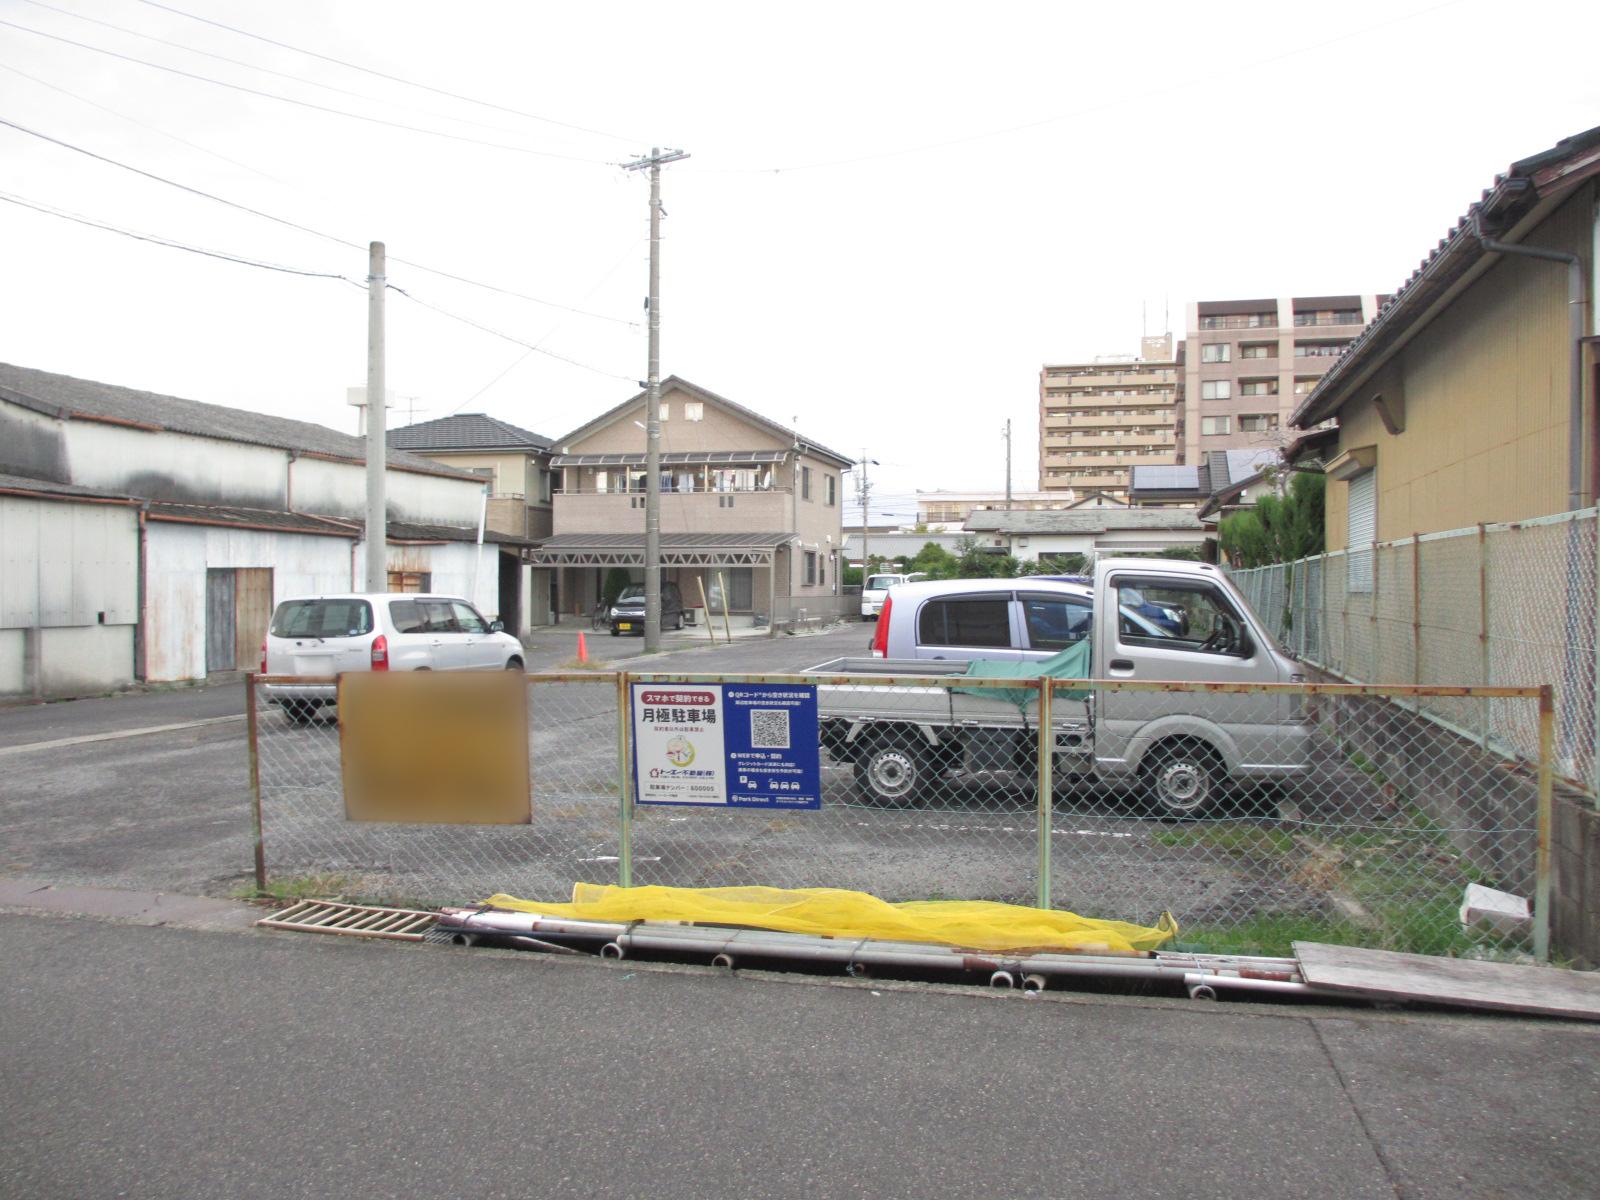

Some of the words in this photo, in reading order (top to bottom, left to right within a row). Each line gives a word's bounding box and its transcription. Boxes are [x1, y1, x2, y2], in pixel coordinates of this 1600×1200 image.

[646, 694, 710, 703] スマホで契約できる
[642, 708, 716, 723] 月極駐車場
